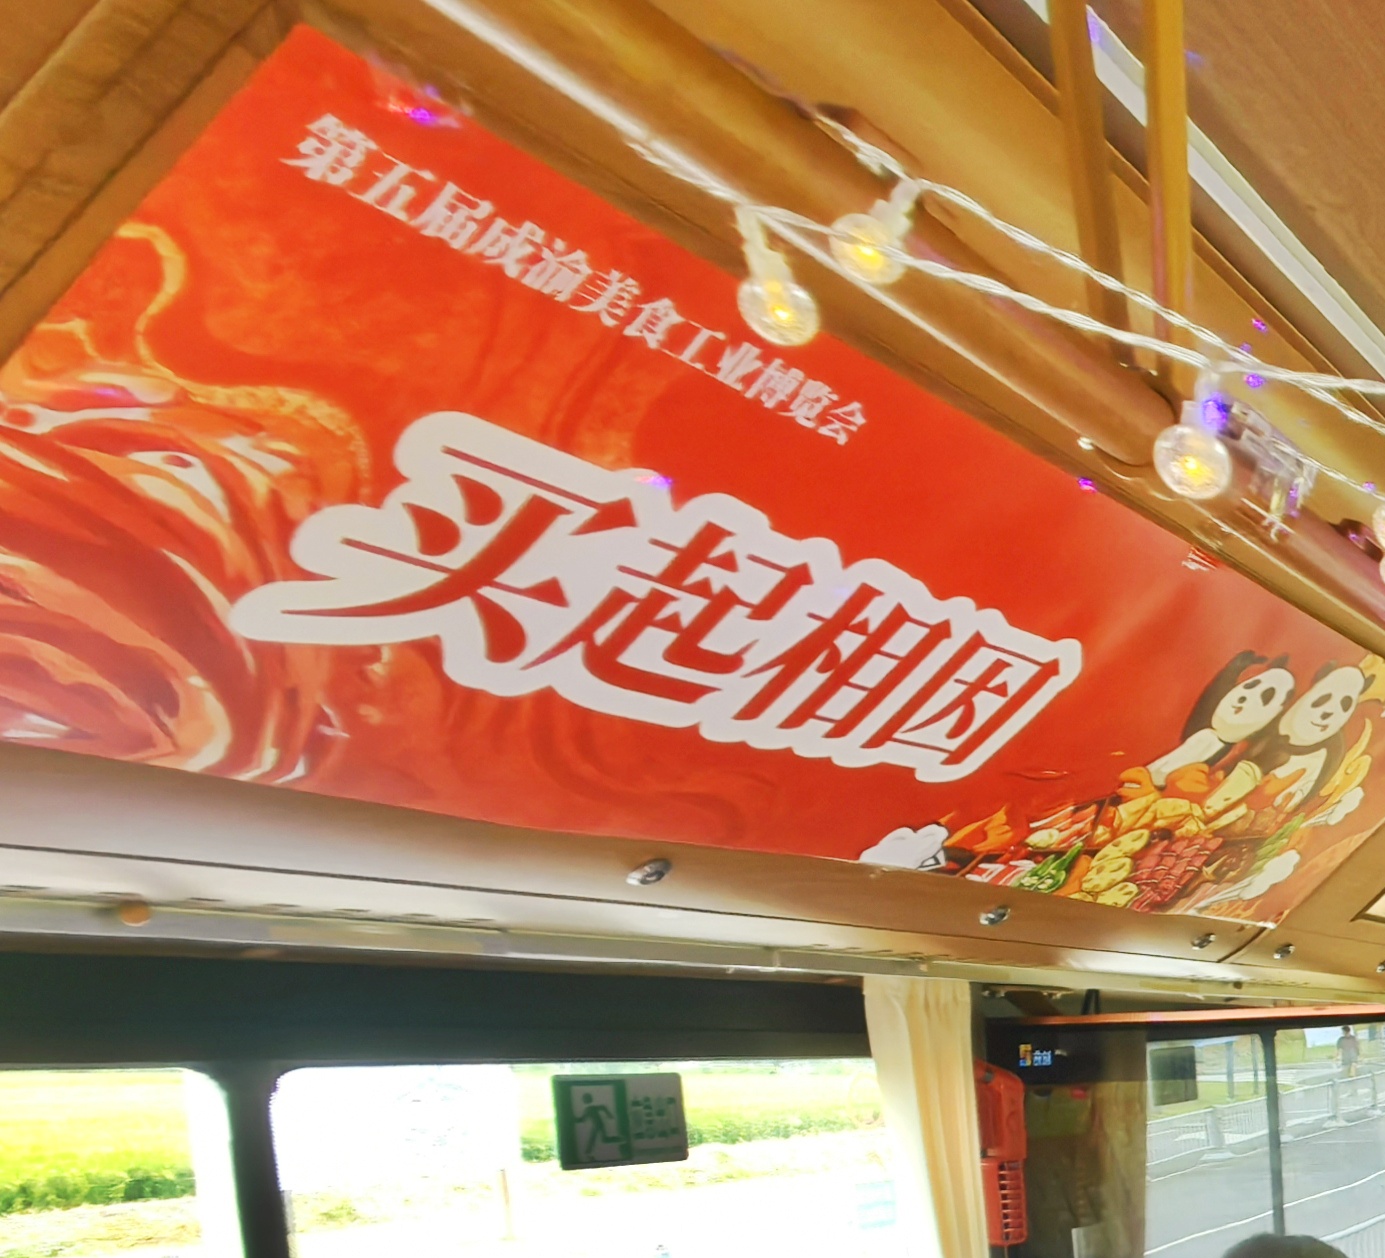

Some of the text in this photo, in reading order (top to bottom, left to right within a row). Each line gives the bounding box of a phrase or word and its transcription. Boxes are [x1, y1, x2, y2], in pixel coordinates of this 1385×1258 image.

[284, 113, 868, 446] 第五届成渝美食工业博览会
[262, 432, 1068, 771] 买起相因
